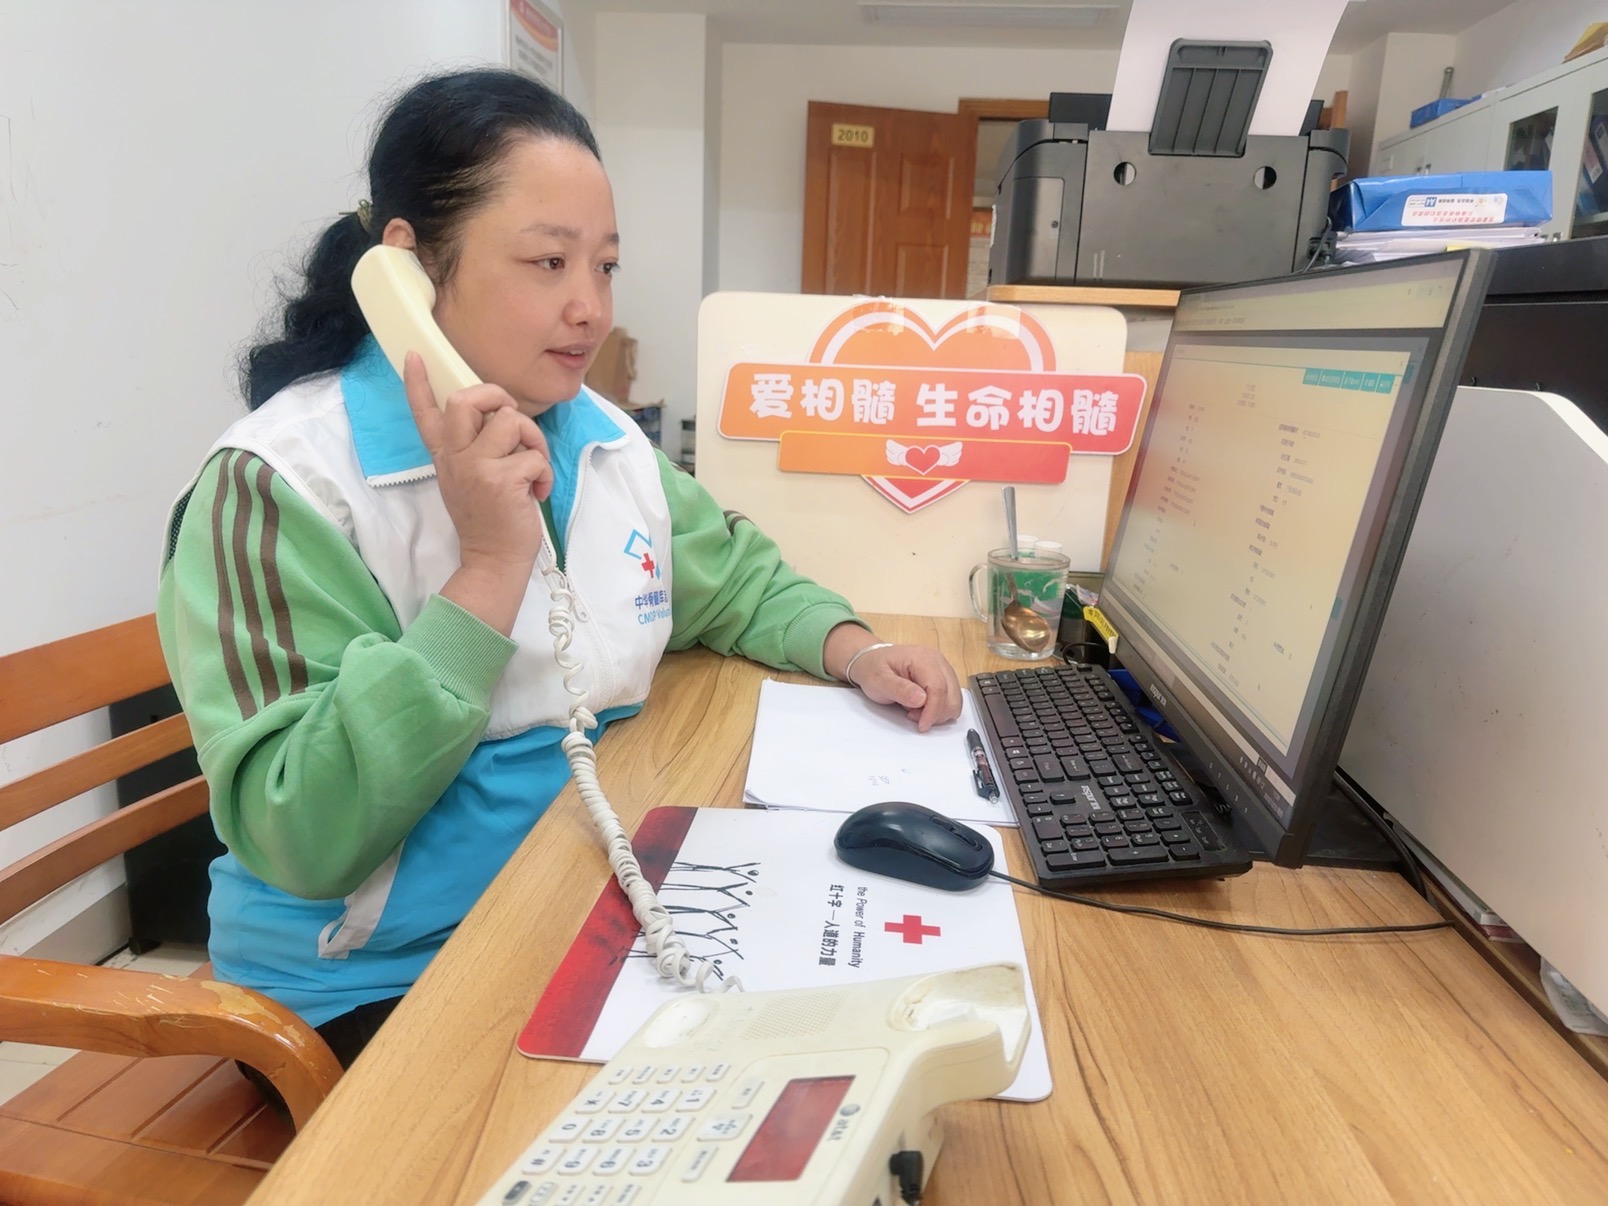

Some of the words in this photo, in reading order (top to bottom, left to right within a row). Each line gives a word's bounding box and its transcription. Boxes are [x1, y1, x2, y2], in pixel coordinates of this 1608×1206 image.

[837, 129, 869, 143] 2010
[749, 373, 896, 425] 爱相髓
[916, 383, 1120, 436] 生命相髓
[857, 886, 868, 897] the
[854, 898, 868, 919] Power
[854, 920, 866, 928] of
[847, 931, 866, 969] Humanity
